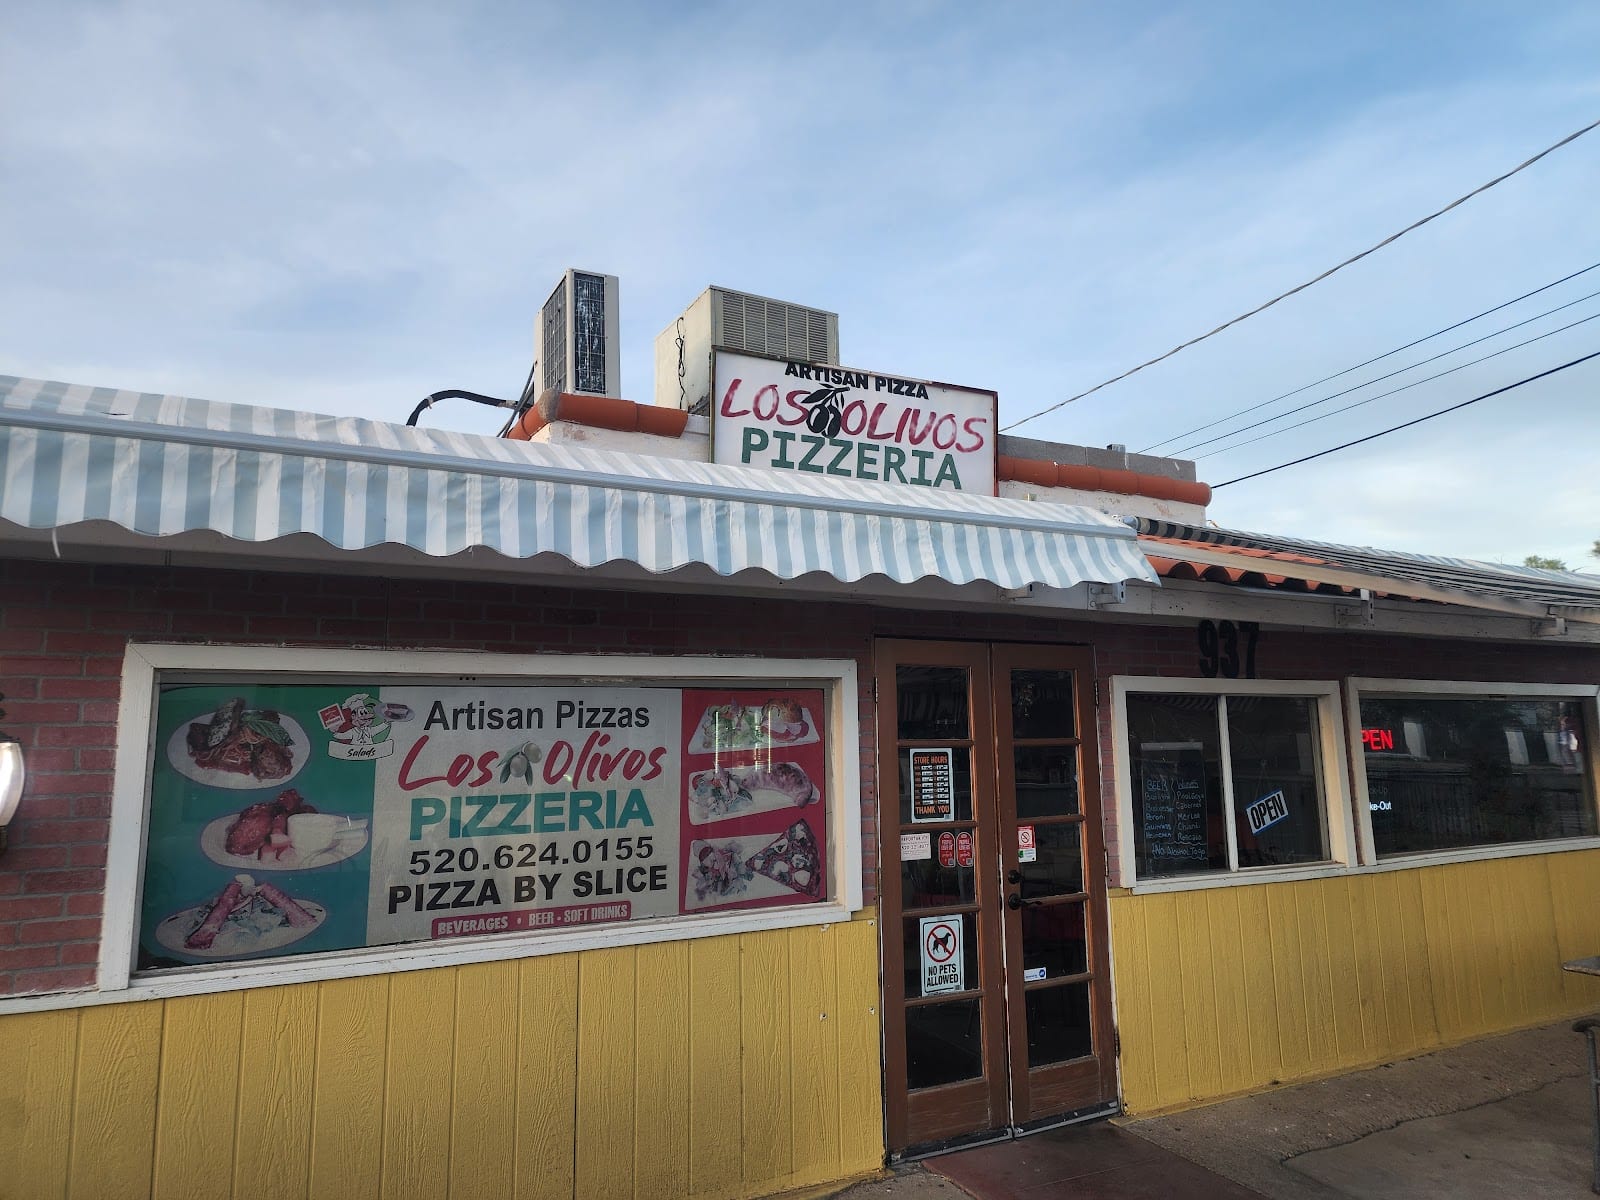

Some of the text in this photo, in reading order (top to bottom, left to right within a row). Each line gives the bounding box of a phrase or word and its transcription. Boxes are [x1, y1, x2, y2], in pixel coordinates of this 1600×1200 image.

[785, 361, 930, 400] ARTISAN PIZZA
[720, 378, 987, 454] LOS OLIVOS
[741, 426, 963, 490] PIZZERIA
[1198, 619, 1259, 679] 937
[423, 700, 650, 731] Artisan Pizzas
[347, 747, 377, 757] Salads
[1360, 728, 1394, 751] PEN
[397, 730, 668, 791] Los Olivos
[914, 756, 930, 765] STORE
[409, 788, 654, 841] PIZZERIA
[915, 805, 950, 815] THANK YOU
[1250, 793, 1285, 829] OPEN
[1369, 801, 1392, 811] ke-Out
[408, 835, 654, 876] 520.624.0155
[387, 865, 668, 915] PIZZA BY SLICE
[437, 904, 628, 935] BEVERAGES BEER SOFT DRINKS
[926, 973, 959, 988] ALLOWED
[928, 963, 956, 977] NO PETS
